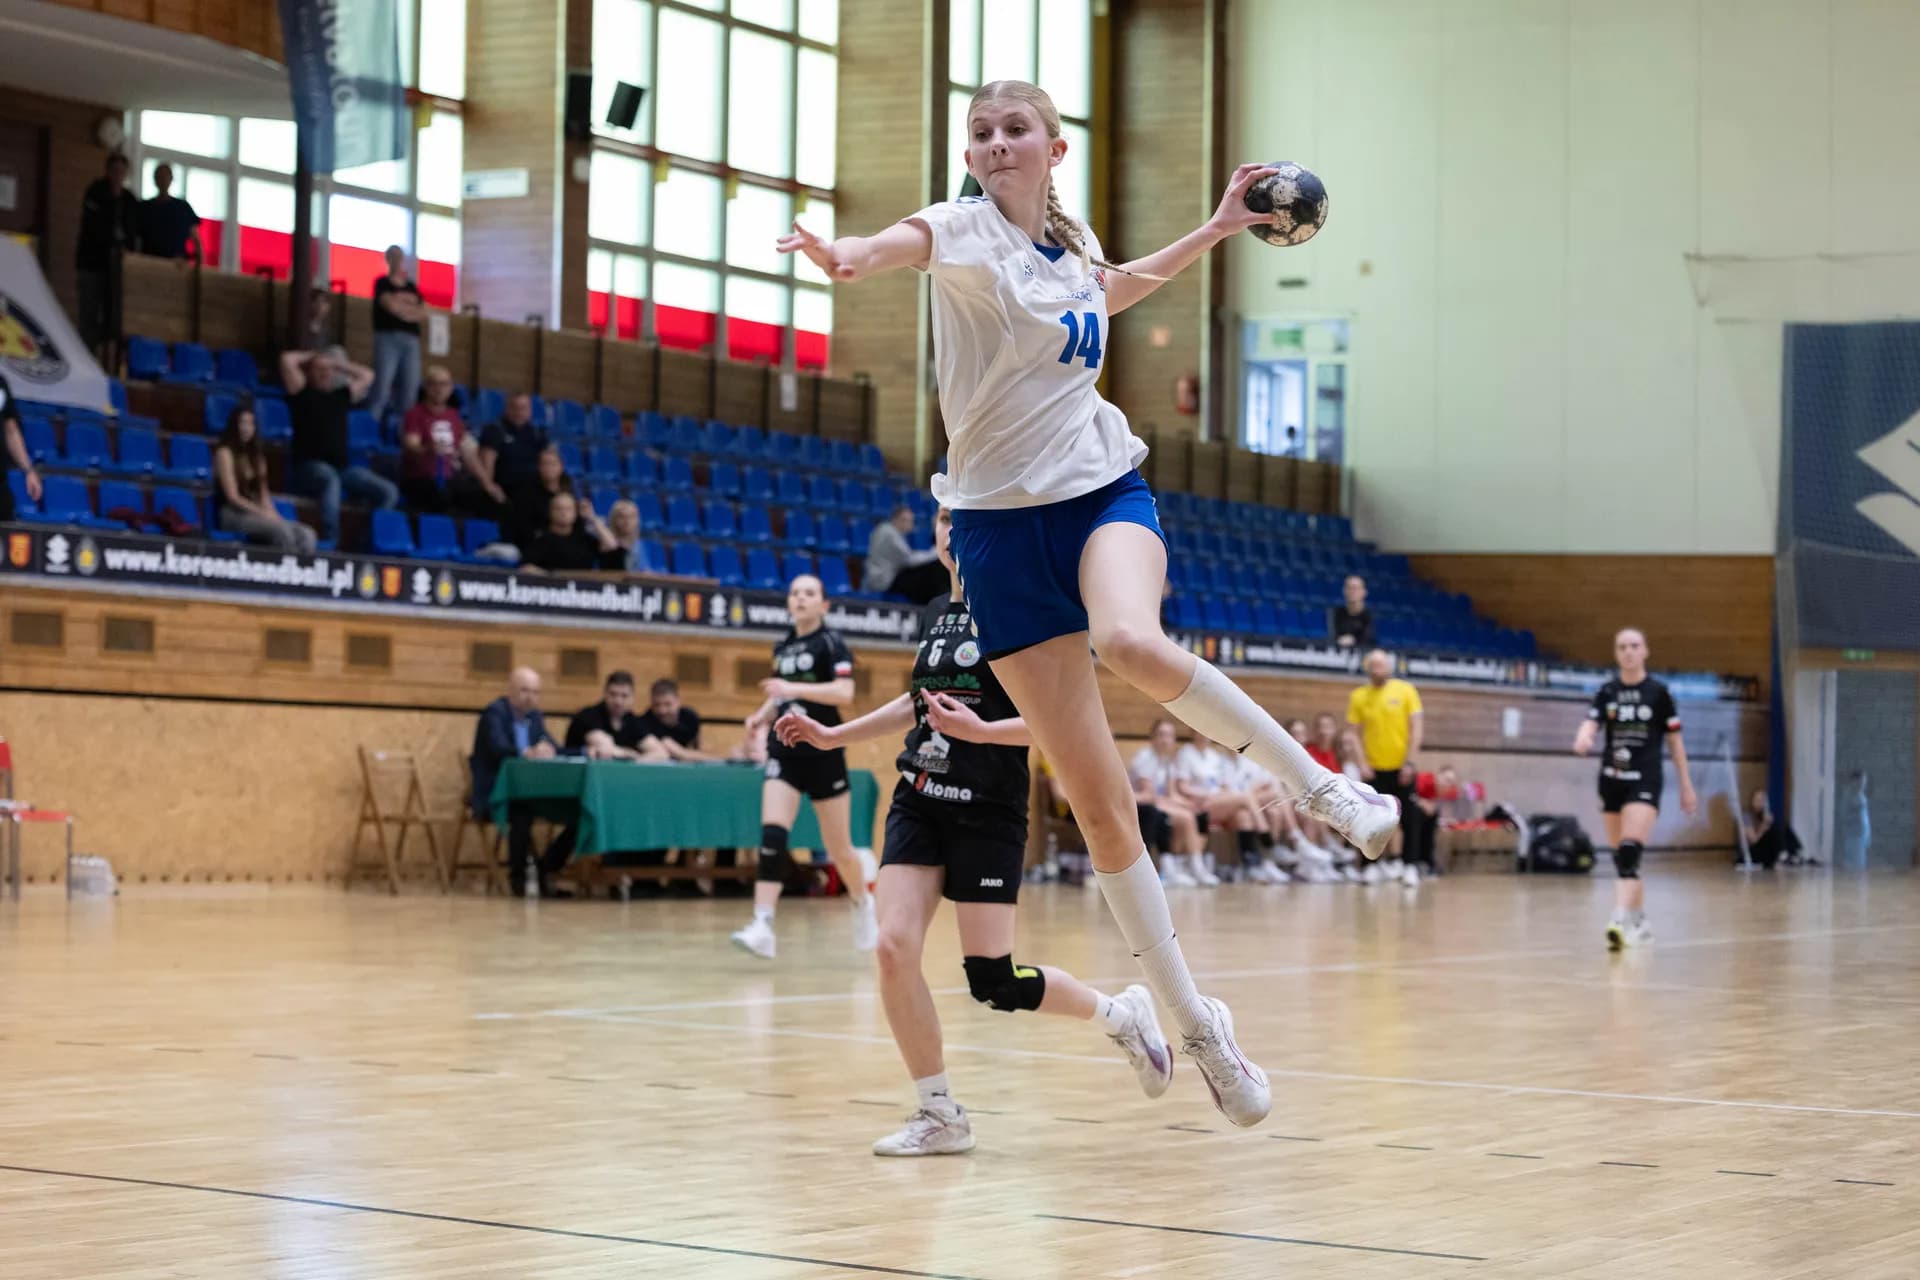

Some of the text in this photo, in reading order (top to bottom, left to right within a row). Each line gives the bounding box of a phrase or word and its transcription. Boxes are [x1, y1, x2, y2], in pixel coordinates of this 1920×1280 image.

[1058, 310, 1101, 369] 14
[104, 543, 354, 598] www.koronahandball.pl
[928, 638, 946, 667] 6
